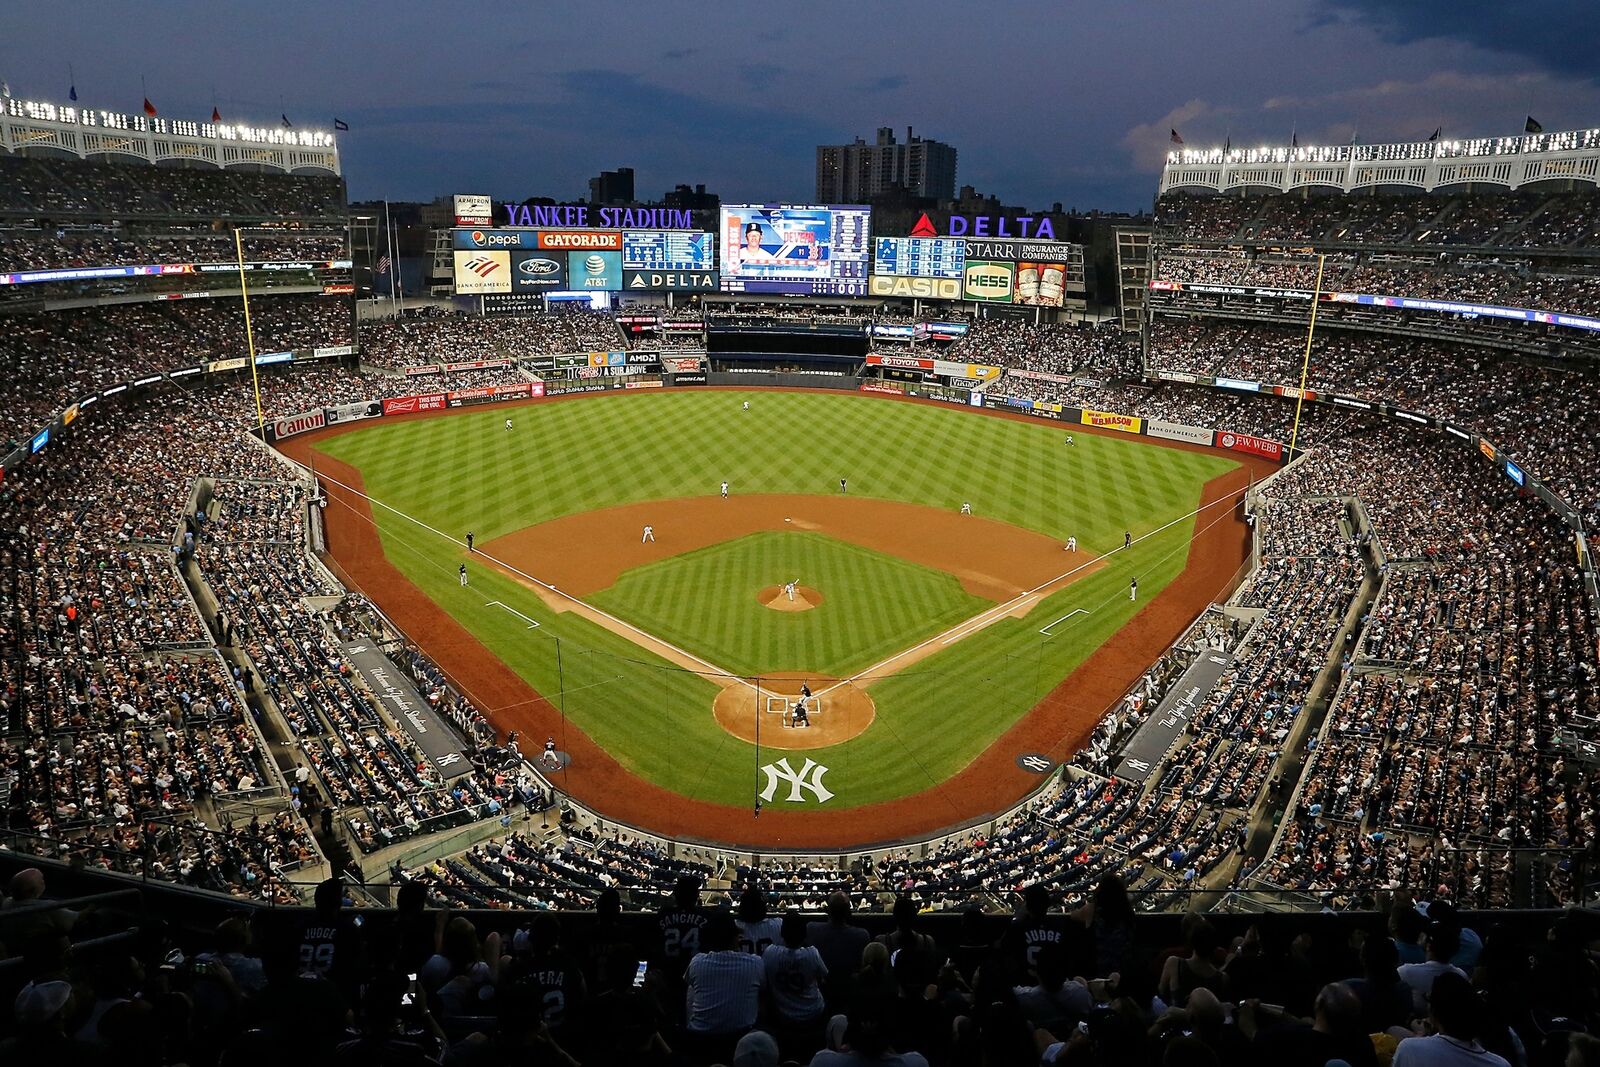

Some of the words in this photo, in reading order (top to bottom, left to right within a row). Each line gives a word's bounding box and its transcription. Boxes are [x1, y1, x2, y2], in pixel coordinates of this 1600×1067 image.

[504, 204, 589, 227] YANKEE
[600, 208, 692, 229] STADIUM
[950, 216, 1056, 238] DELTA
[488, 234, 520, 246] pepsi
[544, 234, 616, 246] GATORADE
[966, 242, 1015, 258] STARR
[1022, 244, 1068, 253] INSURANCE
[1022, 252, 1068, 261] COMPANIES
[527, 260, 552, 272] Ford
[584, 278, 607, 286] AT&T
[652, 274, 713, 286] DELTA
[969, 275, 1008, 288] HESS
[839, 284, 845, 294] 0
[848, 285, 855, 294] 0
[872, 277, 960, 298] CASIO
[892, 358, 919, 366] TOYOTA
[604, 367, 609, 376] A
[626, 366, 646, 374] ABOVE
[952, 378, 978, 387] VIKING
[276, 414, 323, 436] Canon
[1236, 437, 1251, 447] F.W.
[1253, 440, 1277, 453] WEBB
[370, 667, 390, 688] Welcome
[404, 710, 427, 733] Stadium
[1158, 716, 1178, 729] New
[1180, 686, 1200, 708] Yankees
[759, 758, 835, 803] NY
[659, 913, 708, 929] SANCHEZ
[304, 927, 337, 940] JUDGE
[1024, 928, 1062, 945] JUDGE
[664, 928, 701, 958] 24
